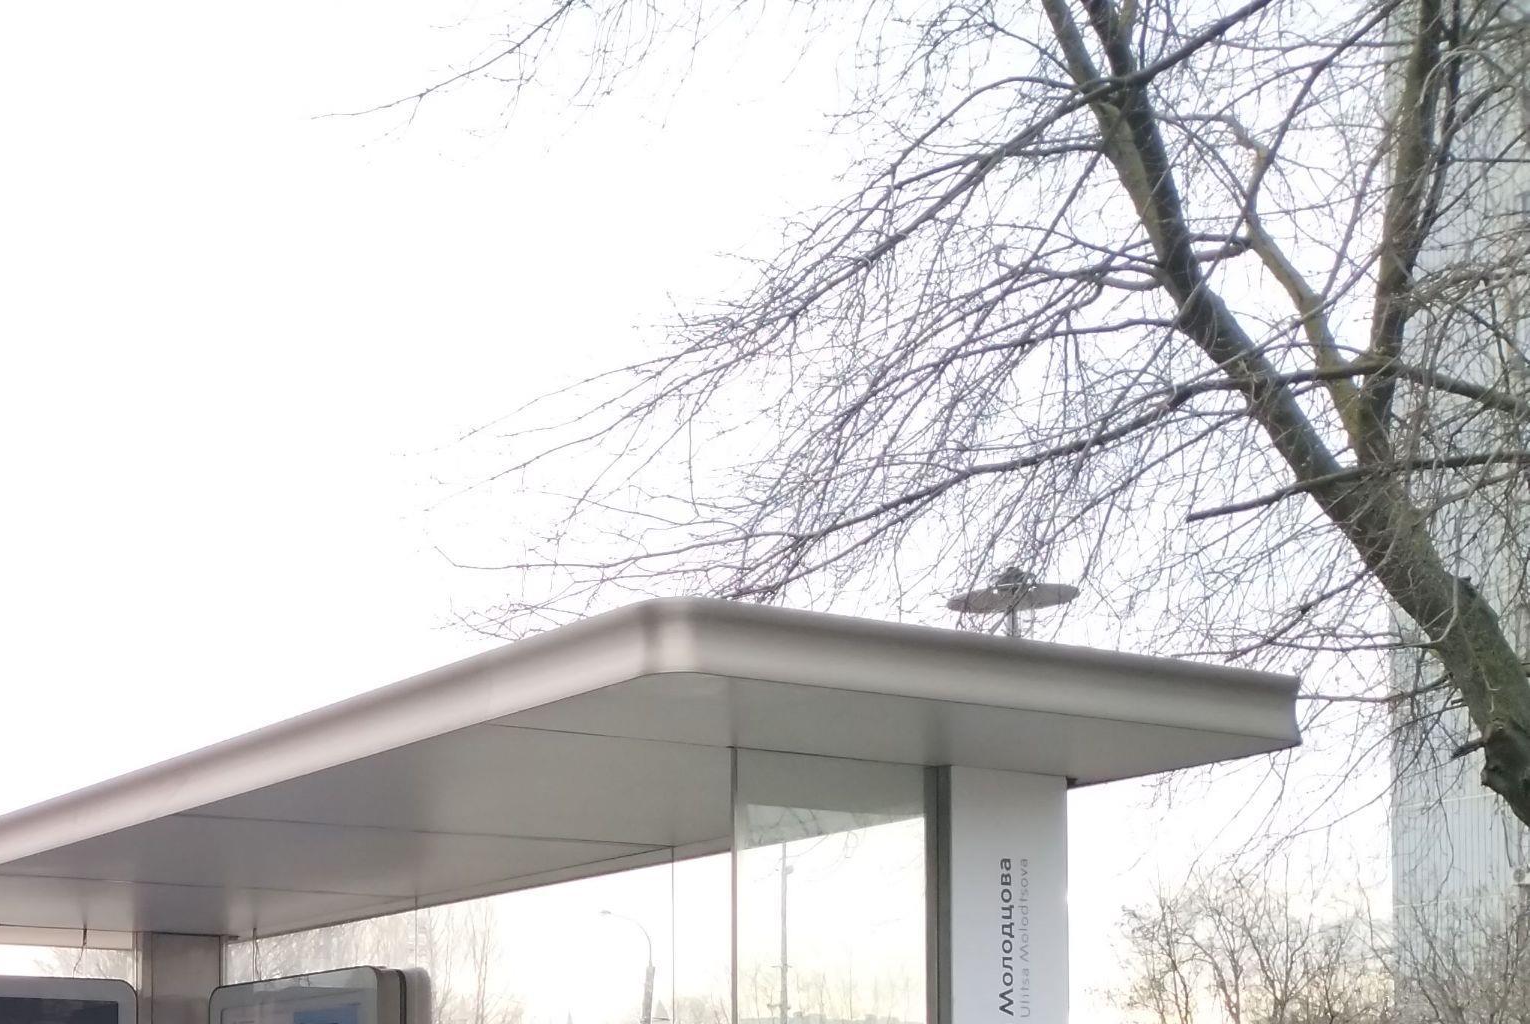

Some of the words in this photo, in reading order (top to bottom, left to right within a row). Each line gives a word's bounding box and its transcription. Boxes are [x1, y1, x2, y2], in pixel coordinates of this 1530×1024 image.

[999, 858, 1014, 1016] Молодцова
[1019, 858, 1030, 962] Molodtsova
[1019, 968, 1031, 1018] Ulitsa
